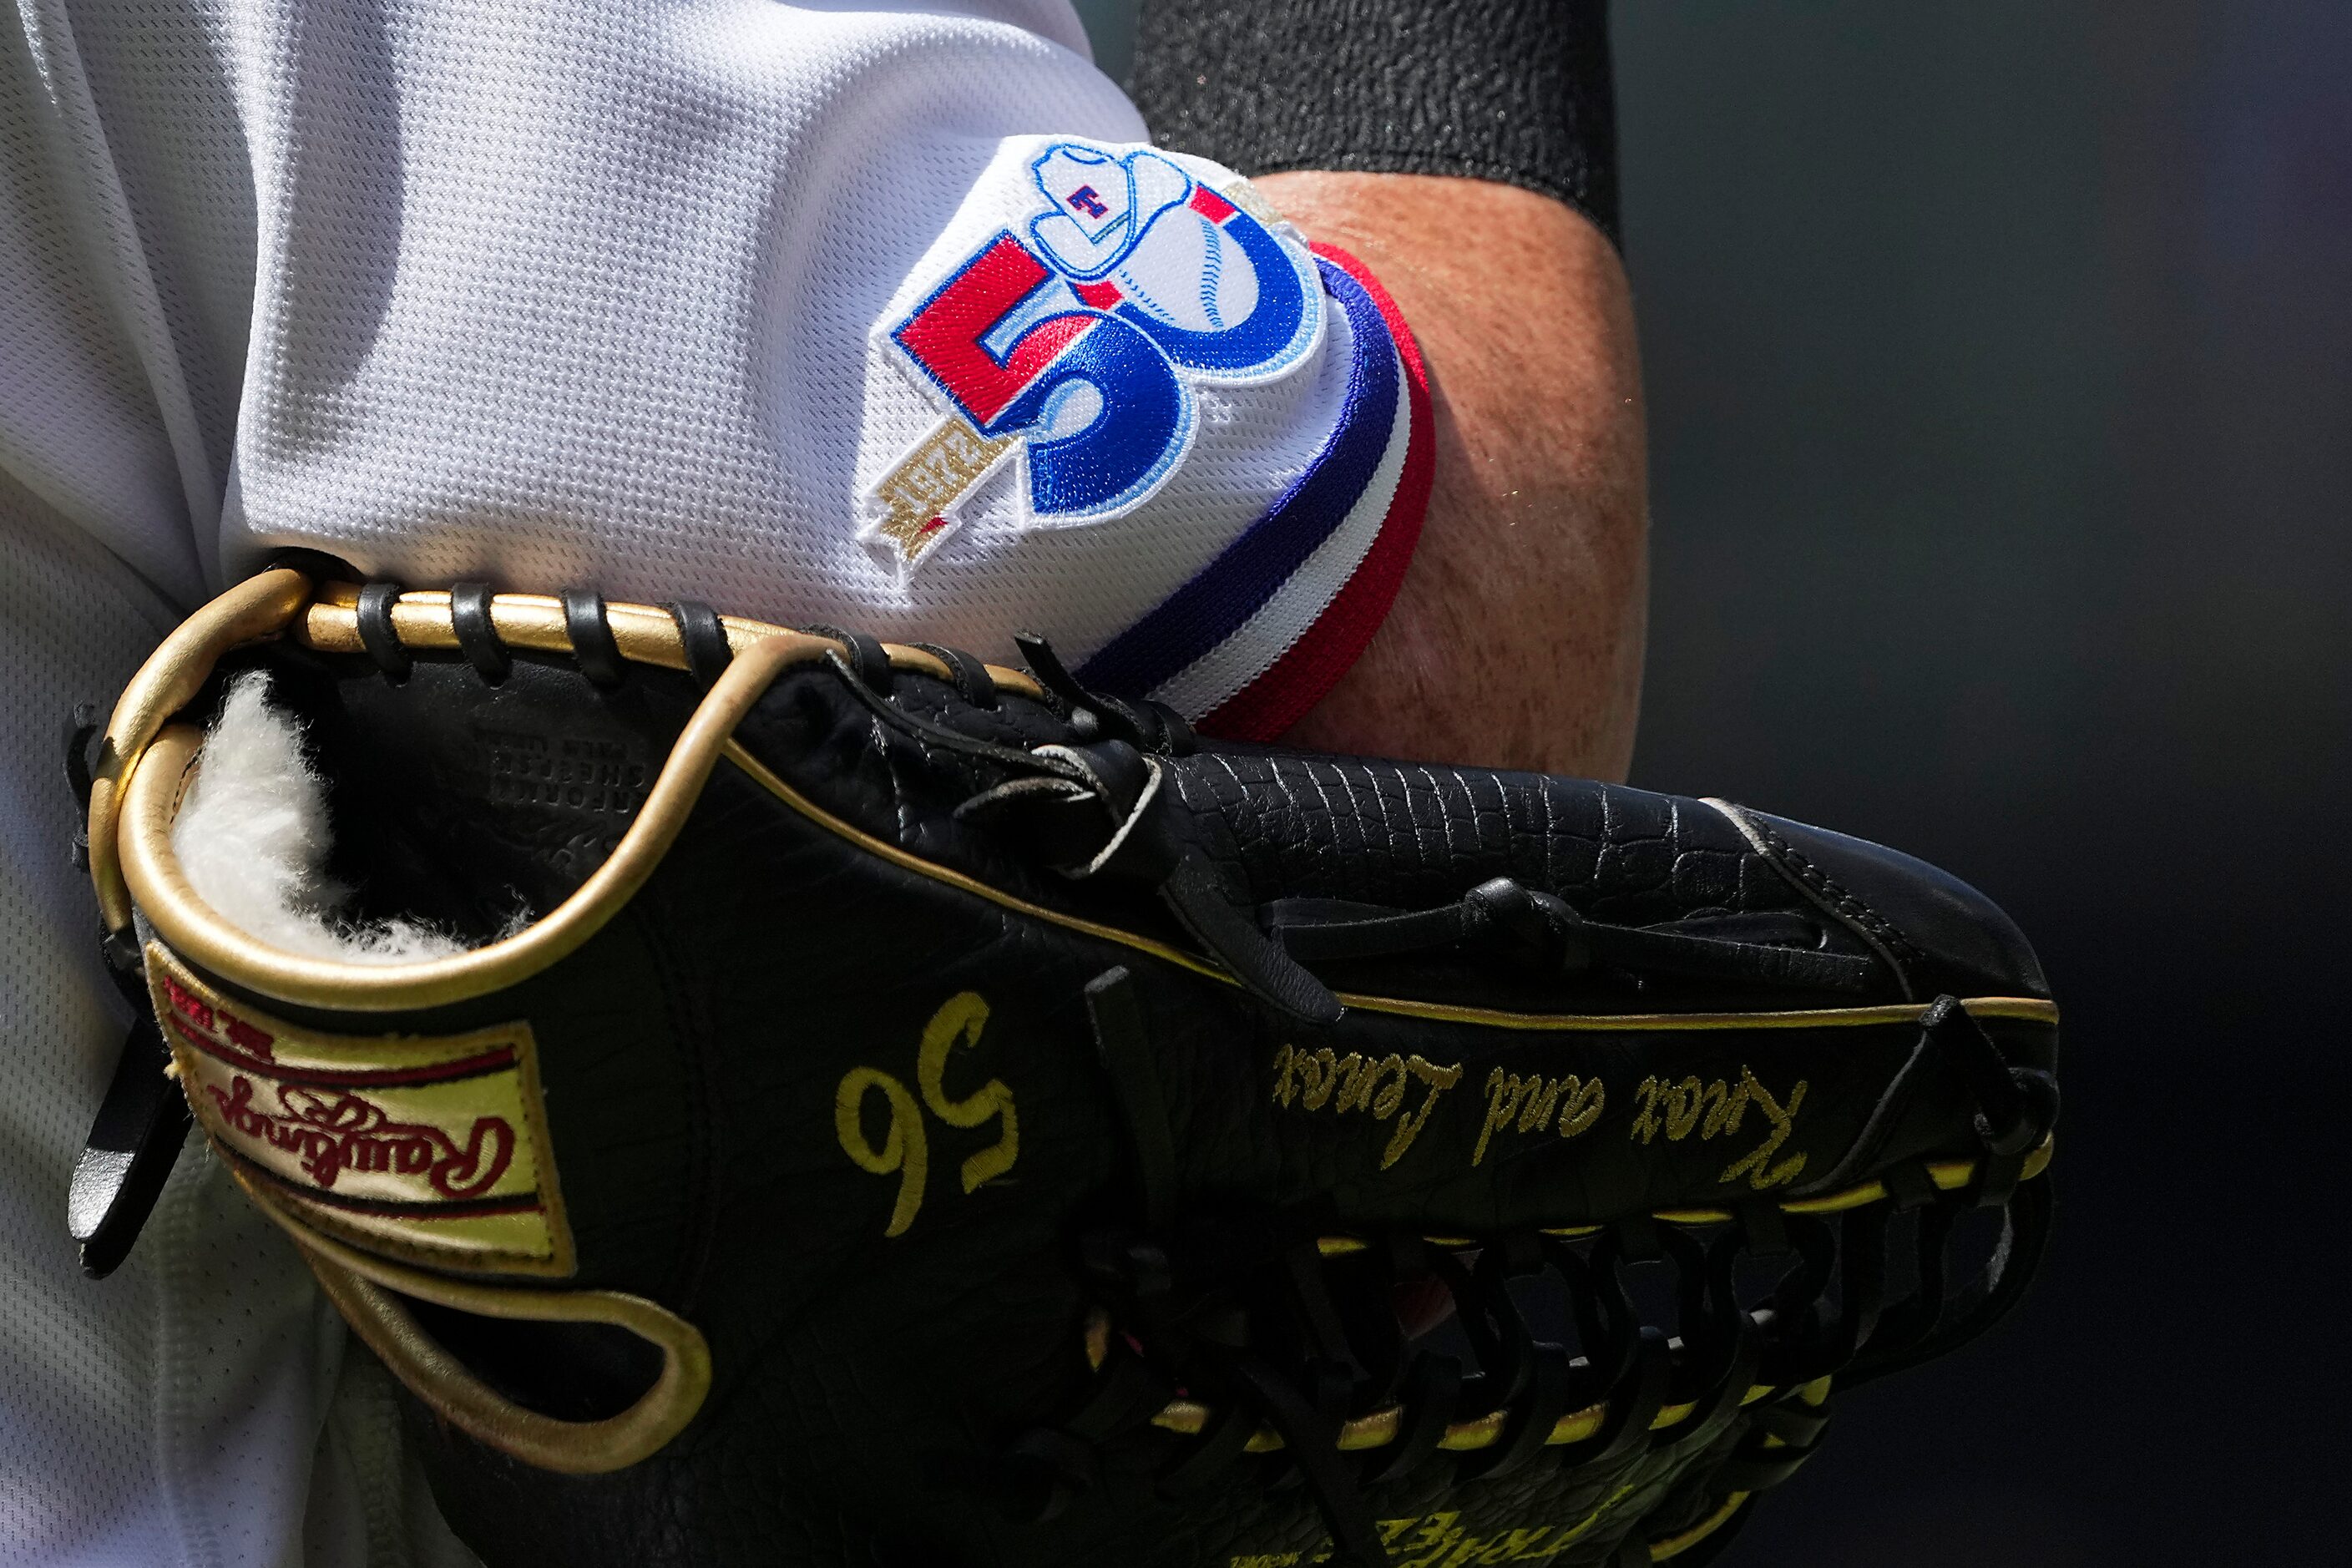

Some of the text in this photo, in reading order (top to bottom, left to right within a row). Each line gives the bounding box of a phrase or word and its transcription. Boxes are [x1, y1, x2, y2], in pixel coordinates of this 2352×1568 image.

[891, 179, 1313, 515] 50
[893, 429, 983, 515] 1972
[207, 1076, 515, 1200] Rawlings
[834, 991, 1019, 1238] 56
[1471, 1065, 1605, 1168] and
